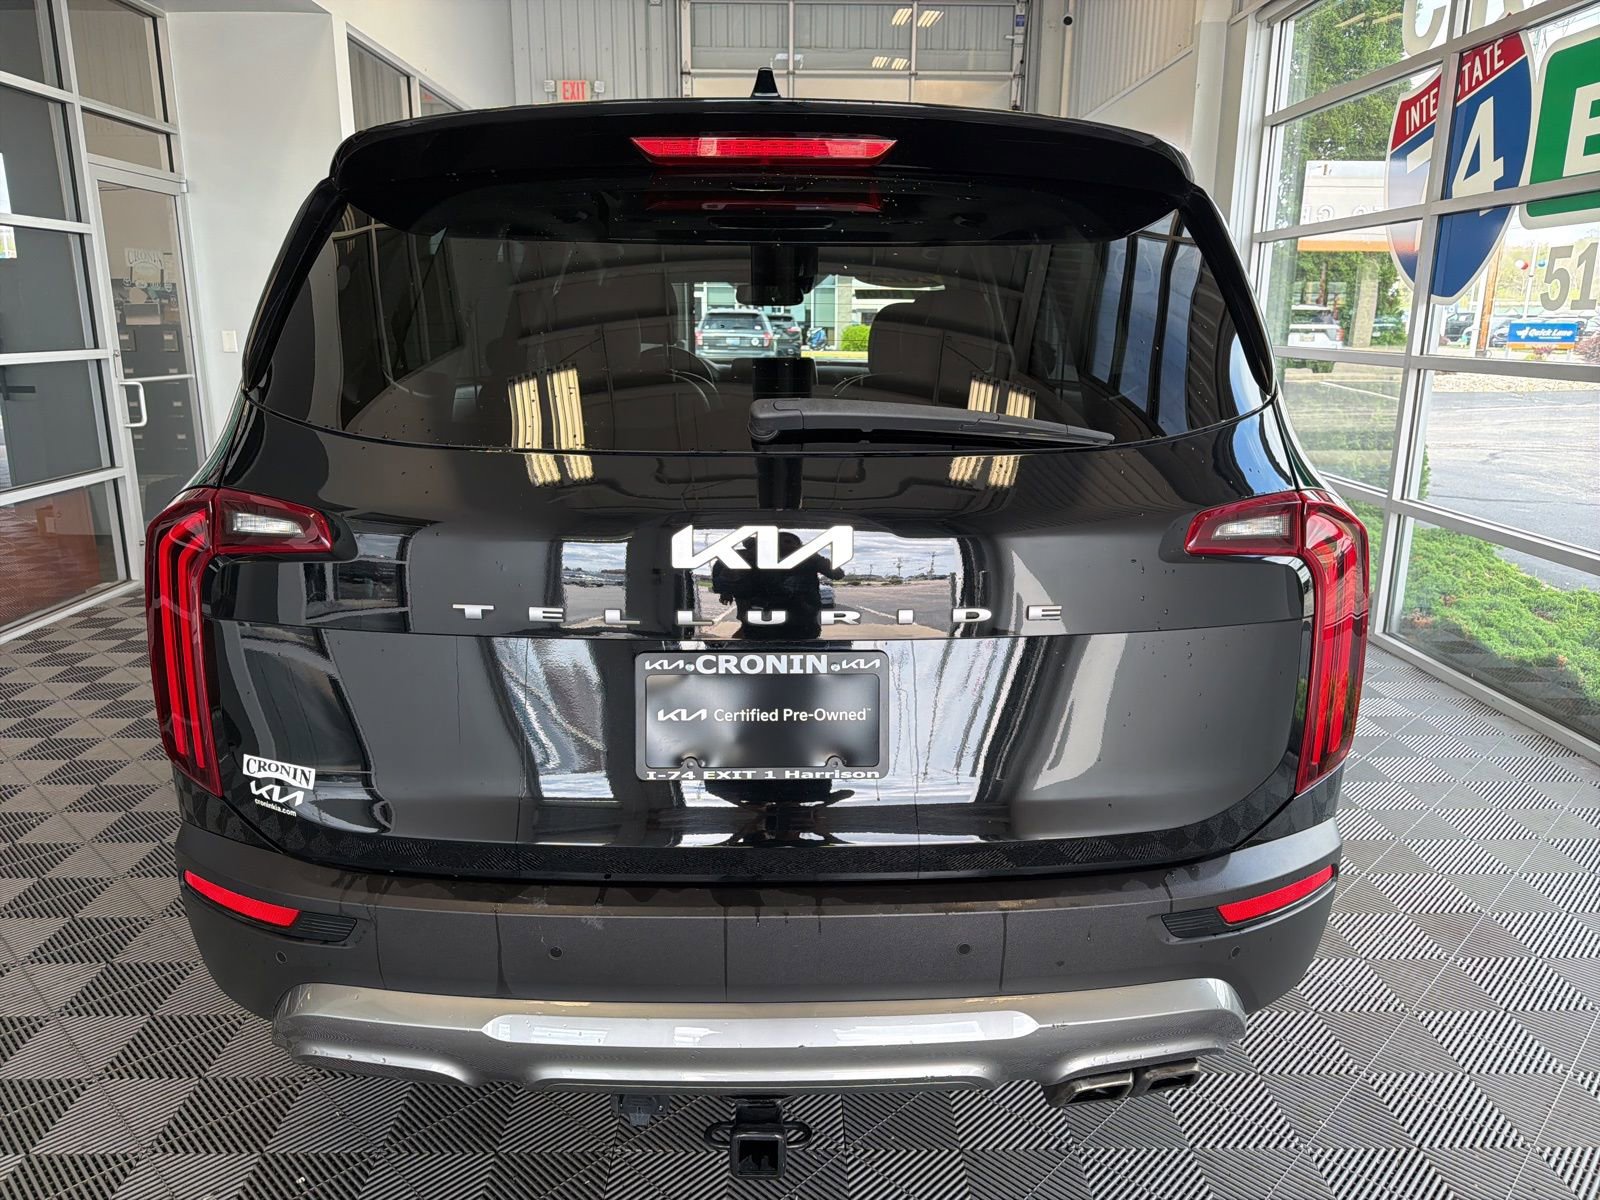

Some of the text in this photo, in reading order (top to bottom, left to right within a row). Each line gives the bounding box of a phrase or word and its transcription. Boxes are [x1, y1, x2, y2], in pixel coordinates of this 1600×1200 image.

[562, 80, 585, 100] EXIT
[1405, 38, 1504, 136] INTETATE
[1529, 328, 1553, 336] Quick
[453, 603, 1063, 625] TELLURIDE
[695, 654, 828, 675] CRONIN
[713, 708, 779, 722] Certified
[246, 757, 312, 788] CRONIN
[646, 769, 880, 780] I-74 EXIT 1 Harrison
[254, 798, 297, 817] croninkia.com
